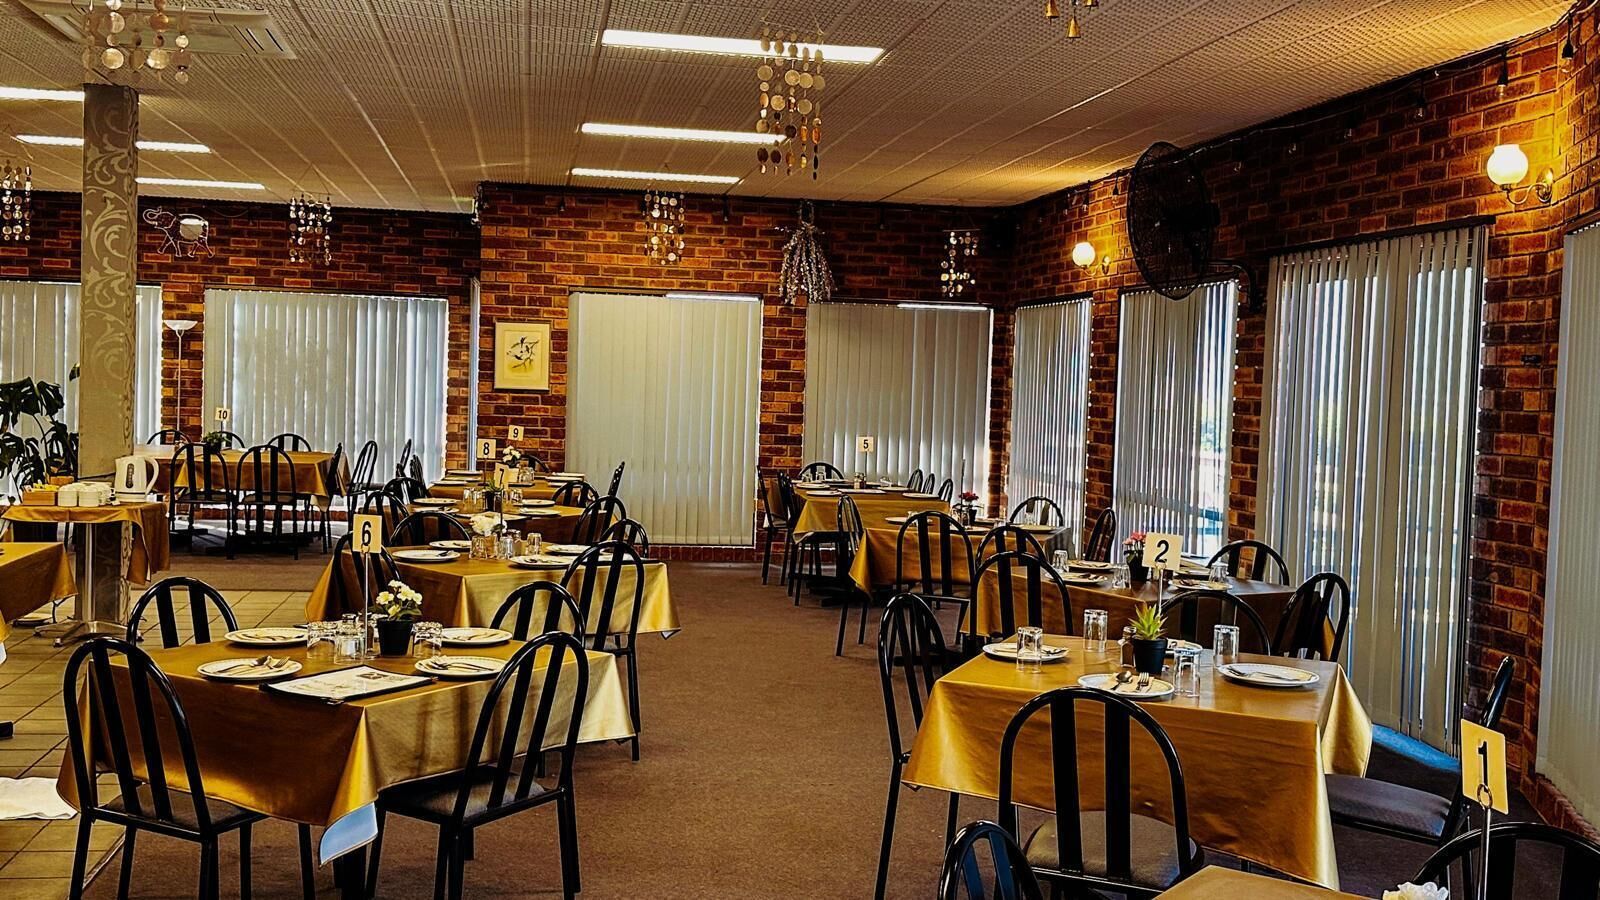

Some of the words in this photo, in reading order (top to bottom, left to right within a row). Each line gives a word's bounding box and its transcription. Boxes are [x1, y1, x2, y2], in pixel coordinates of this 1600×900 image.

[218, 409, 228, 420] 10
[513, 427, 519, 438] 9
[483, 442, 490, 455] 8
[863, 439, 869, 449] 5
[499, 468, 505, 486] 7
[362, 520, 372, 546] 6
[1154, 539, 1169, 563] 2
[1478, 741, 1489, 793] 1
